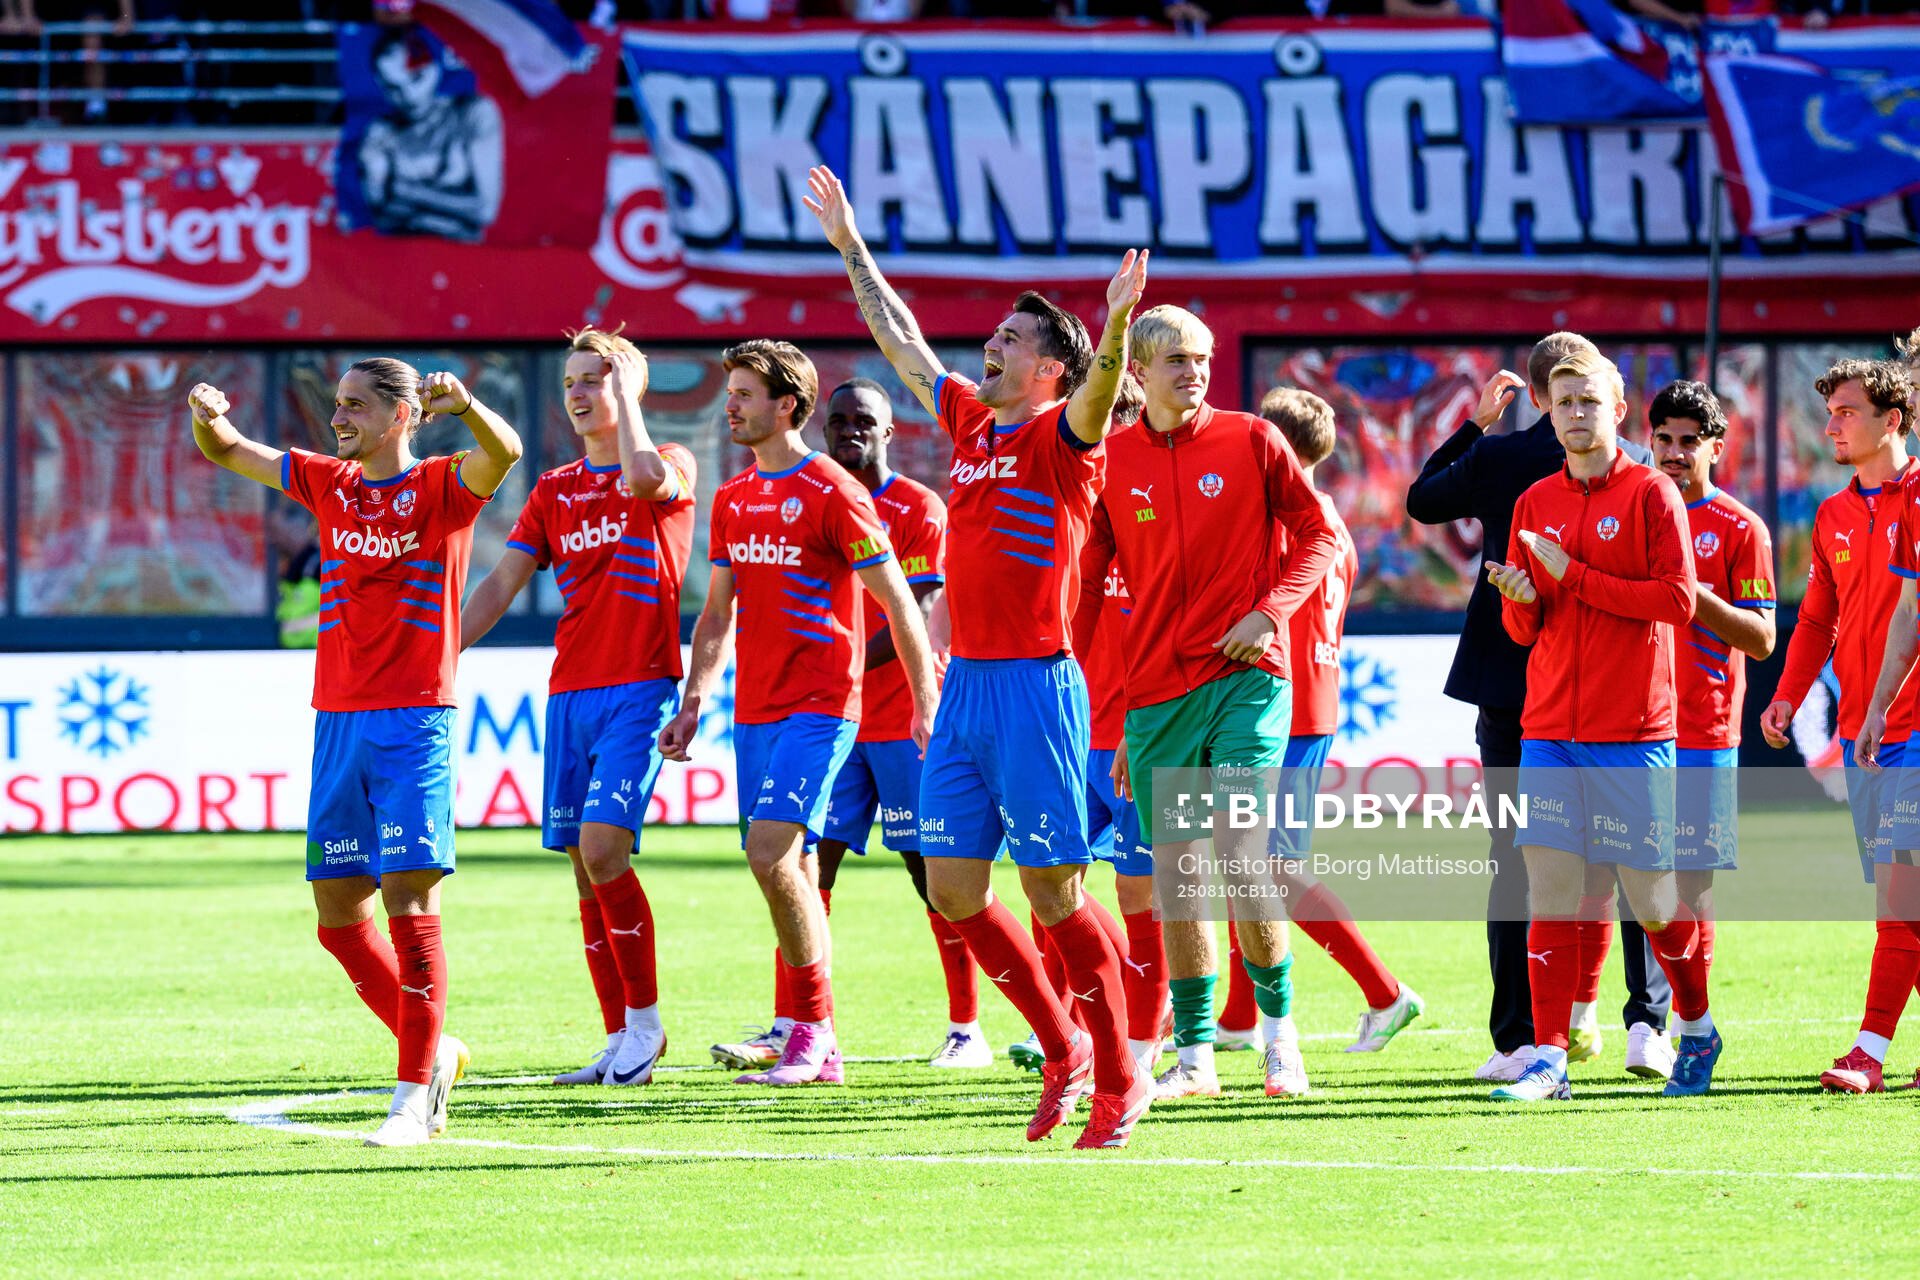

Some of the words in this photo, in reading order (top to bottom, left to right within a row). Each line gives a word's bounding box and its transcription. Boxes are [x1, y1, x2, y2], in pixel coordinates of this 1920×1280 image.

[640, 32, 1906, 248] SKÅNEPÅGAR
[1135, 507, 1156, 523] XXL
[332, 524, 420, 559] vobbiz
[560, 512, 629, 555] vobbi
[727, 533, 802, 567] vobbiz
[849, 535, 883, 561] XXL
[1835, 549, 1851, 564] XXL
[901, 554, 931, 577] XXL
[1740, 578, 1771, 599] XXL
[1217, 763, 1252, 779] Fibio
[620, 778, 632, 793] 14
[798, 777, 807, 791] 7
[1218, 783, 1254, 795] Resurs
[1163, 805, 1195, 820] Solid
[1532, 796, 1564, 814] Solid
[884, 806, 913, 823] ibio
[1040, 813, 1048, 829] 2
[1530, 809, 1571, 828] Försäkring
[426, 819, 435, 833] 8
[919, 817, 945, 832] Solid
[1593, 814, 1628, 835] Fibio
[324, 838, 359, 855] Solid
[1602, 836, 1632, 851] Resurs
[325, 852, 370, 866] Försäkring
